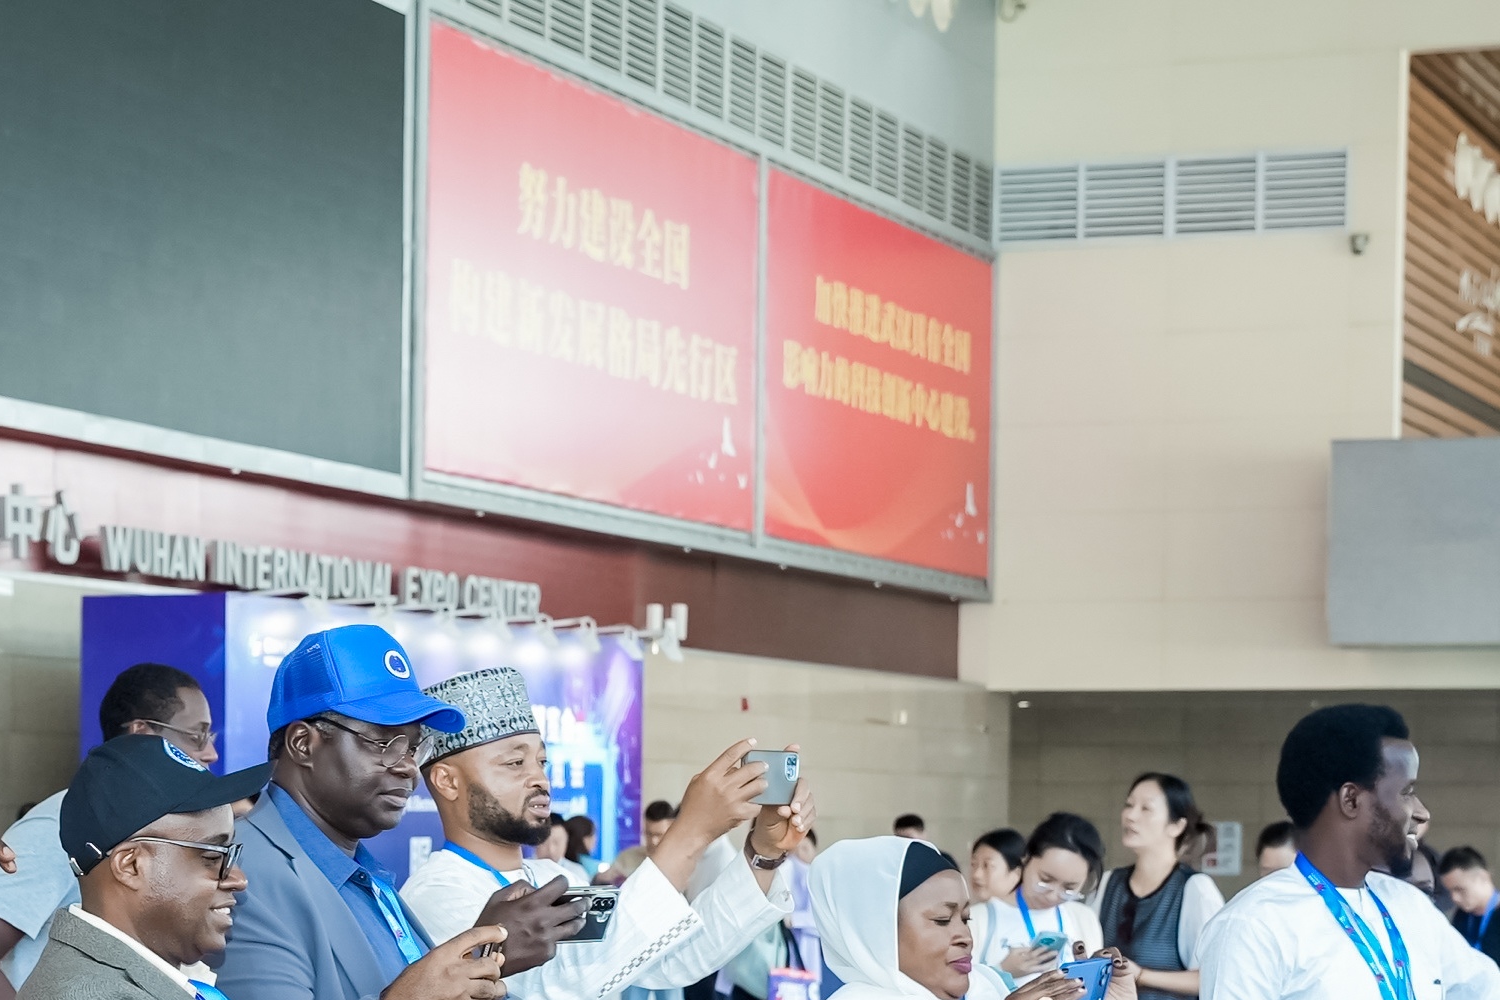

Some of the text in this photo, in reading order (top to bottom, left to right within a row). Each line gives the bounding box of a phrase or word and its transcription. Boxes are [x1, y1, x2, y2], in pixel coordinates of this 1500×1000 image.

[516, 161, 690, 291] 努力建设全国
[101, 525, 542, 622] WUHAN INTERNATIONAL EXPO CENTER
